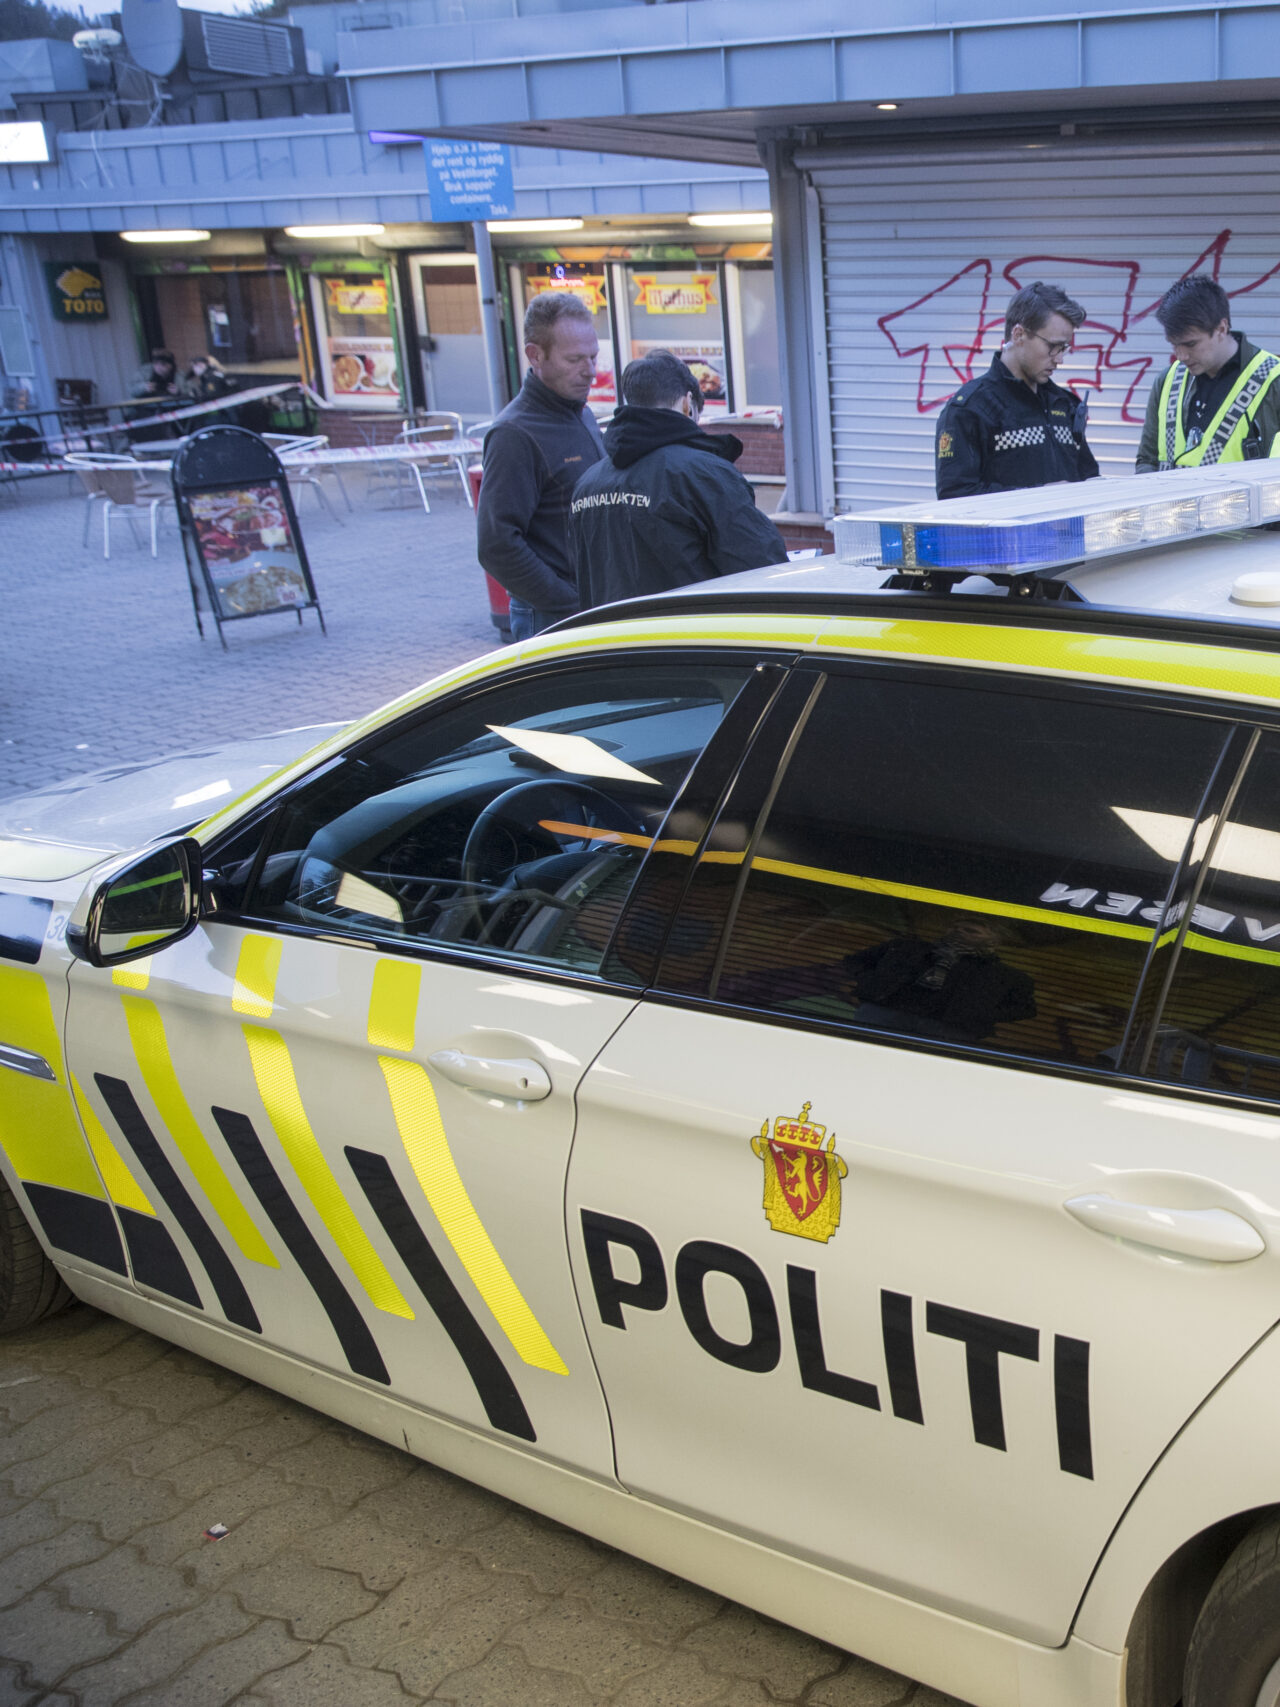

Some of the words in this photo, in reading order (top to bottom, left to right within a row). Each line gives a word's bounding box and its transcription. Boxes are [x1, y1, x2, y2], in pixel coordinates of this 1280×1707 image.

[431, 158, 445, 168] det
[446, 156, 463, 167] rent
[465, 156, 477, 168] og
[478, 153, 504, 166] ryddig
[490, 204, 509, 216] Takk
[63, 298, 105, 314] TOTO
[1215, 378, 1262, 441] POLITI
[571, 491, 651, 514] KRIMINALVAKTEN
[579, 1206, 1095, 1482] POLITI
